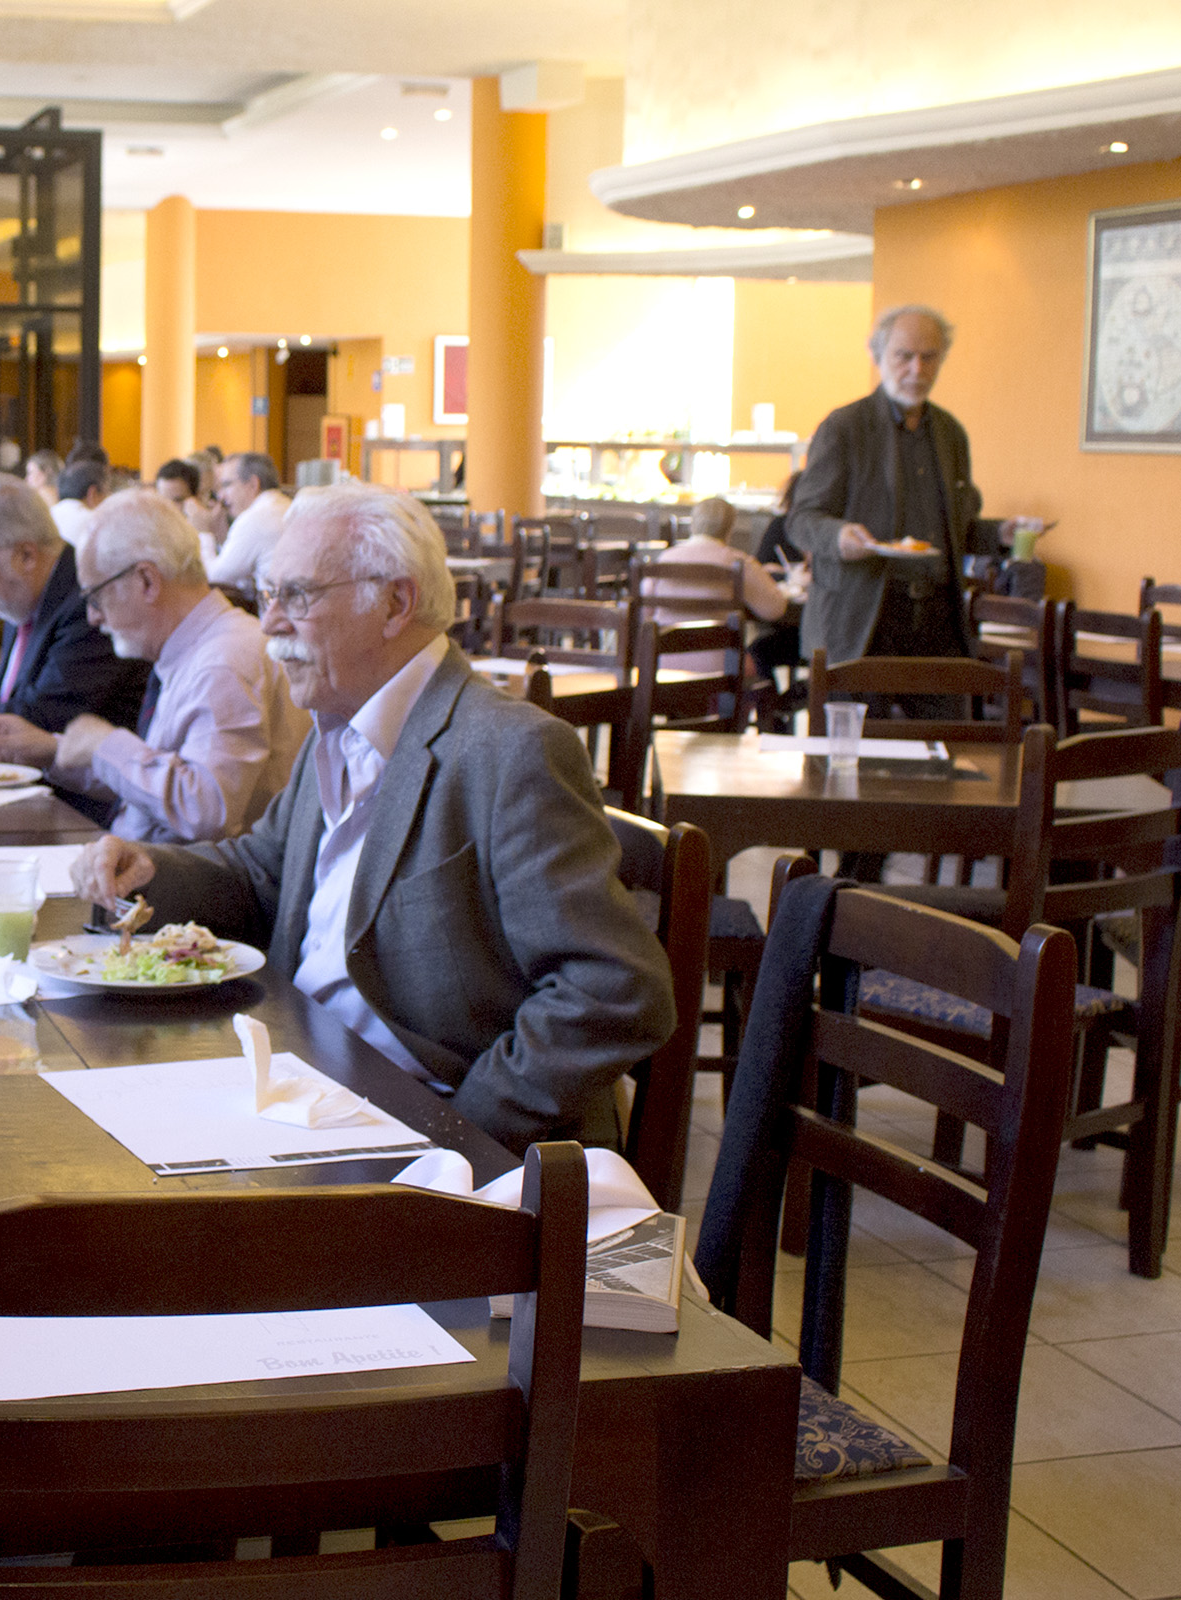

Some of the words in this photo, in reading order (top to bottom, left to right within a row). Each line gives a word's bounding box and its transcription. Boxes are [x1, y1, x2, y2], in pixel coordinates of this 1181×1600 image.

[276, 1333, 381, 1346] RESTAURANTE
[256, 1356, 324, 1371] Bom
[331, 1347, 423, 1366] Apetite
